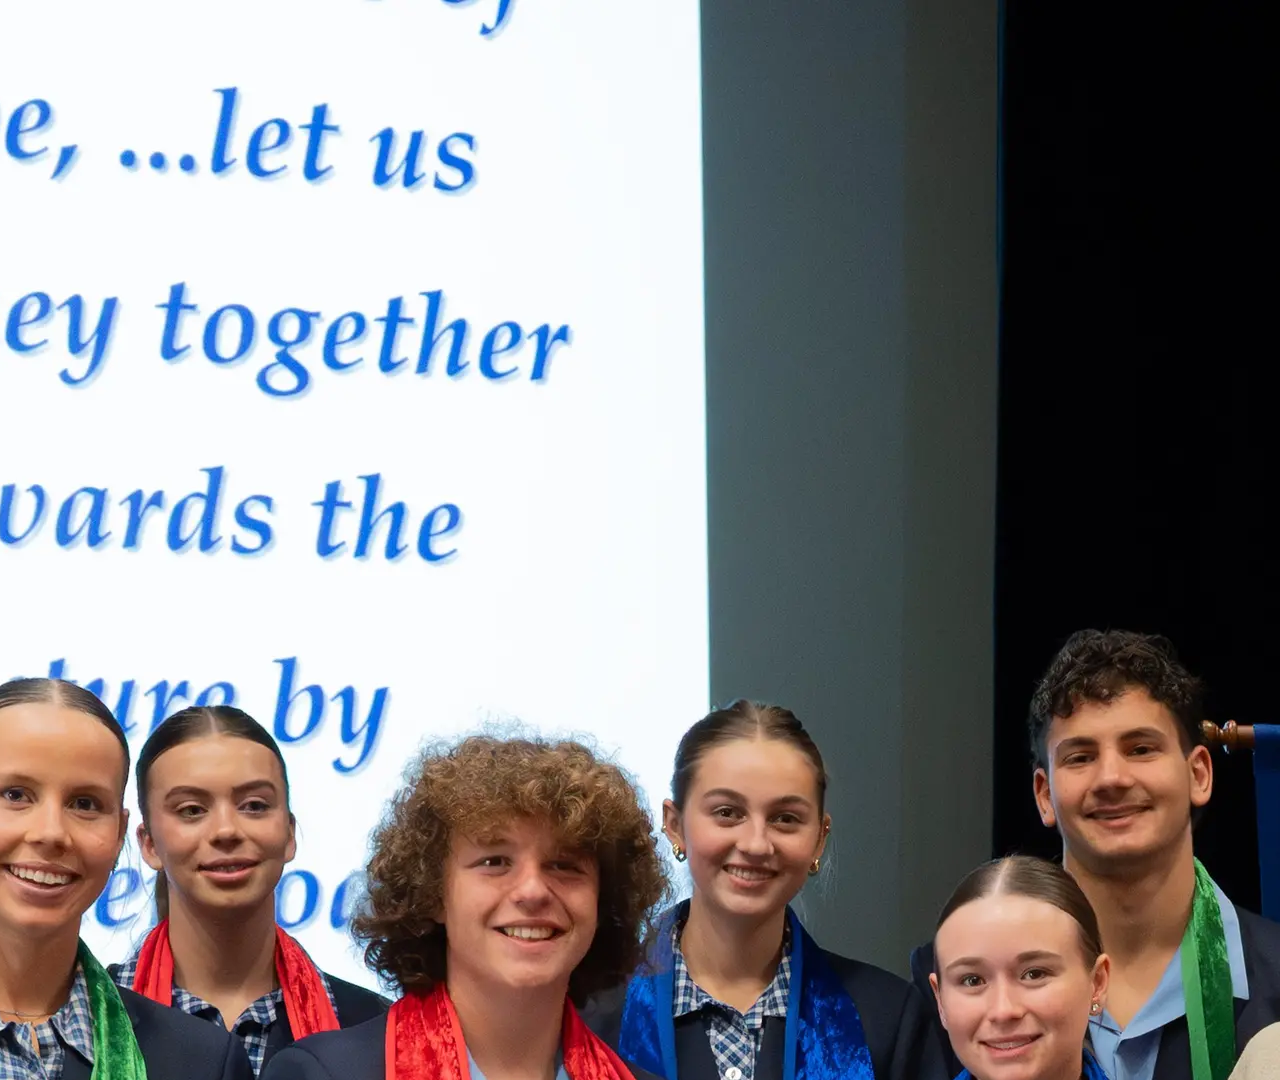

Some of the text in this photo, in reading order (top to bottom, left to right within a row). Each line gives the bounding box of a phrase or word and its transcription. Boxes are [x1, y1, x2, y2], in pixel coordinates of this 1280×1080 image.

[120, 87, 340, 182] ...let
[368, 124, 478, 194] us
[155, 281, 572, 398] together
[311, 472, 466, 565] the
[272, 656, 391, 774] by
